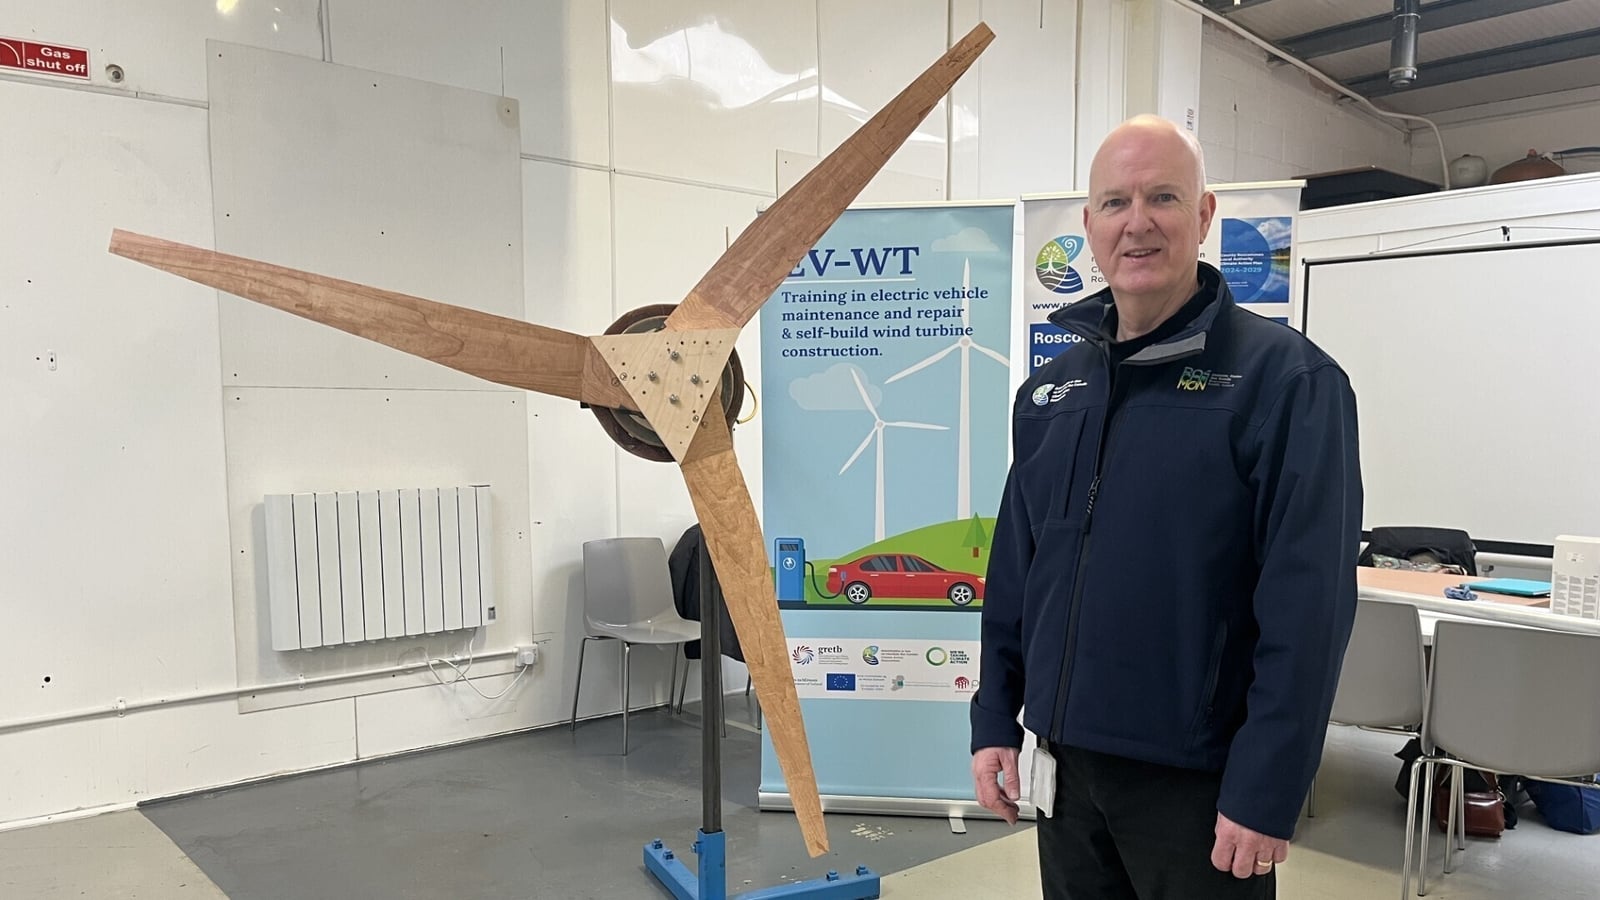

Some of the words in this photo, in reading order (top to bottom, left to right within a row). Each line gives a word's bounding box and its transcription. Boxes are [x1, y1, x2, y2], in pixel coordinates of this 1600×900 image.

[40, 47, 71, 60] Gas
[26, 58, 61, 70] shut
[65, 63, 86, 73] off
[781, 290, 848, 305] Training
[851, 289, 866, 302] in
[870, 287, 929, 302] electric
[933, 286, 989, 300] vehicle
[782, 308, 880, 321] maintenance
[884, 306, 912, 320] and
[916, 306, 965, 321] repair
[782, 327, 792, 340] &
[796, 325, 869, 340] self-build
[873, 324, 911, 338] wind
[915, 324, 974, 338] turbine
[1034, 331, 1086, 345] Rosco
[781, 344, 883, 358] construction.
[818, 645, 843, 655] gretb
